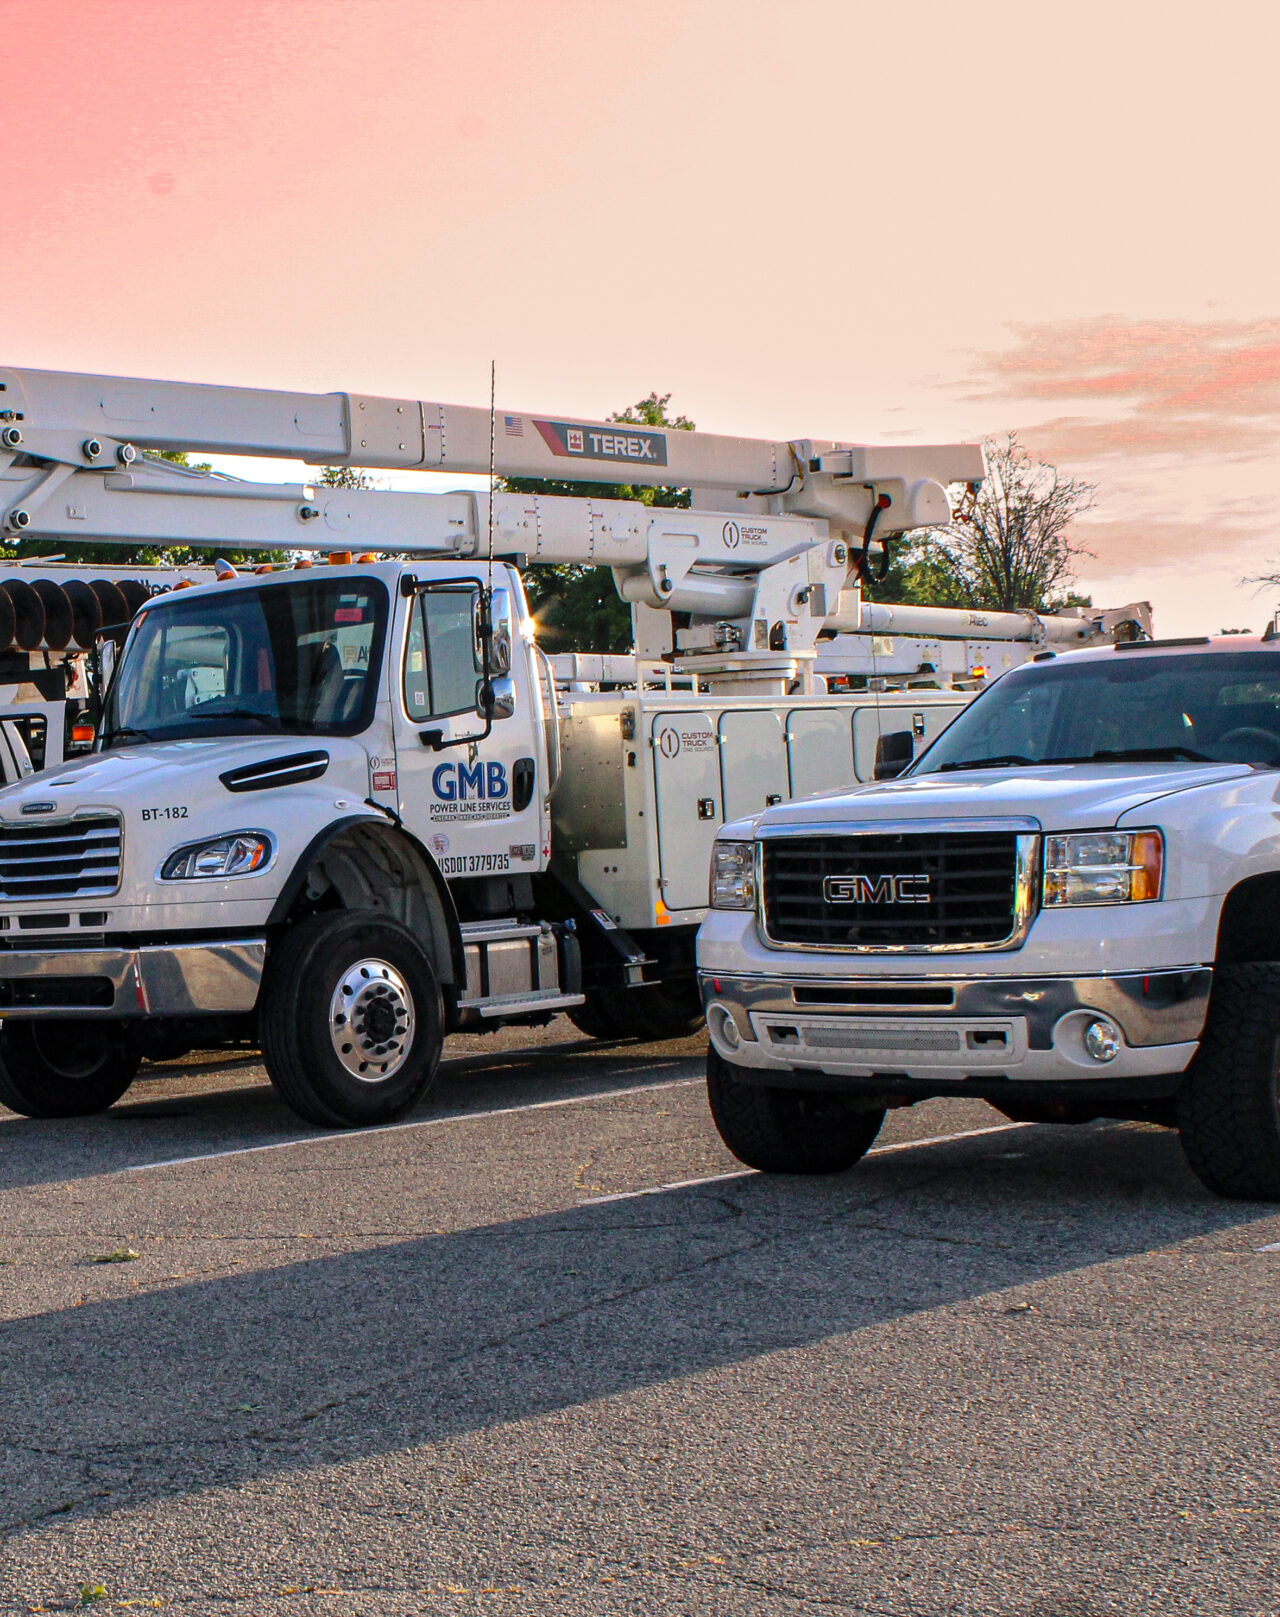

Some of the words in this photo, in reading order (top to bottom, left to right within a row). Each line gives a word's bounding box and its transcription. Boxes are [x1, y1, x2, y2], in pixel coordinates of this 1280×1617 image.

[589, 433, 653, 459] TEREX
[741, 527, 768, 535] CUSTOM
[682, 732, 714, 740] CUSTOM
[683, 739, 707, 747] TRUCK
[432, 762, 509, 802] GMB
[142, 806, 189, 821] BT-182
[430, 803, 458, 814] POWER
[460, 802, 477, 812] LINE
[478, 801, 511, 812] SERVICES
[469, 854, 509, 873] 3779735
[823, 874, 931, 903] GMC
